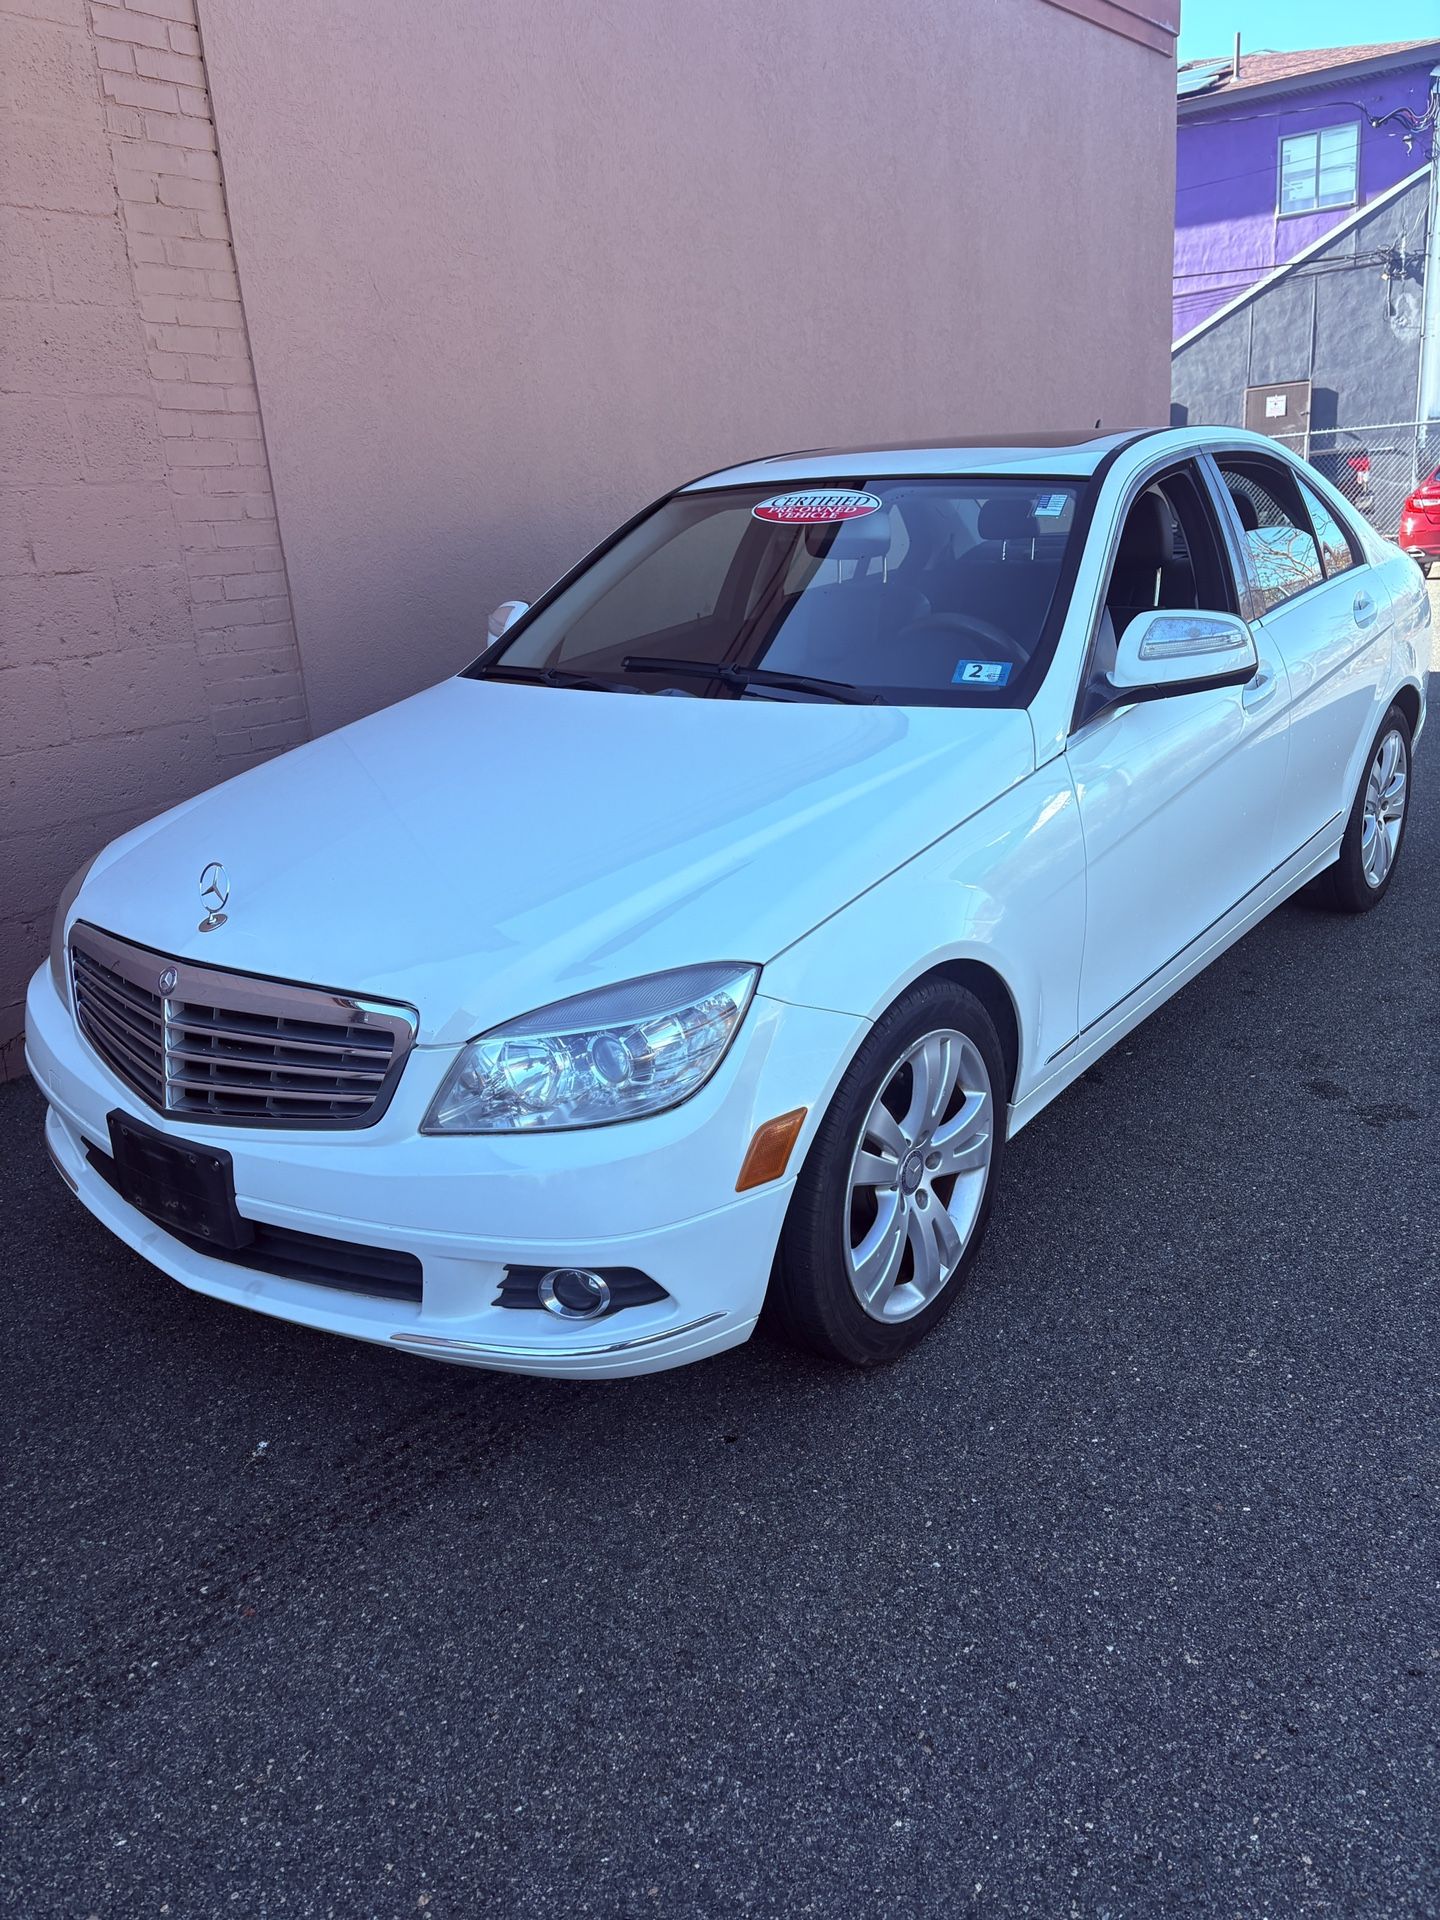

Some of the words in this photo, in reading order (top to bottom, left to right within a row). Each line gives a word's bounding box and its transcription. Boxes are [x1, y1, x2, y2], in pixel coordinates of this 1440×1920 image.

[771, 496, 871, 506] CERTIFIED
[768, 506, 857, 514] PRE-OWNED
[968, 664, 983, 678] 2
